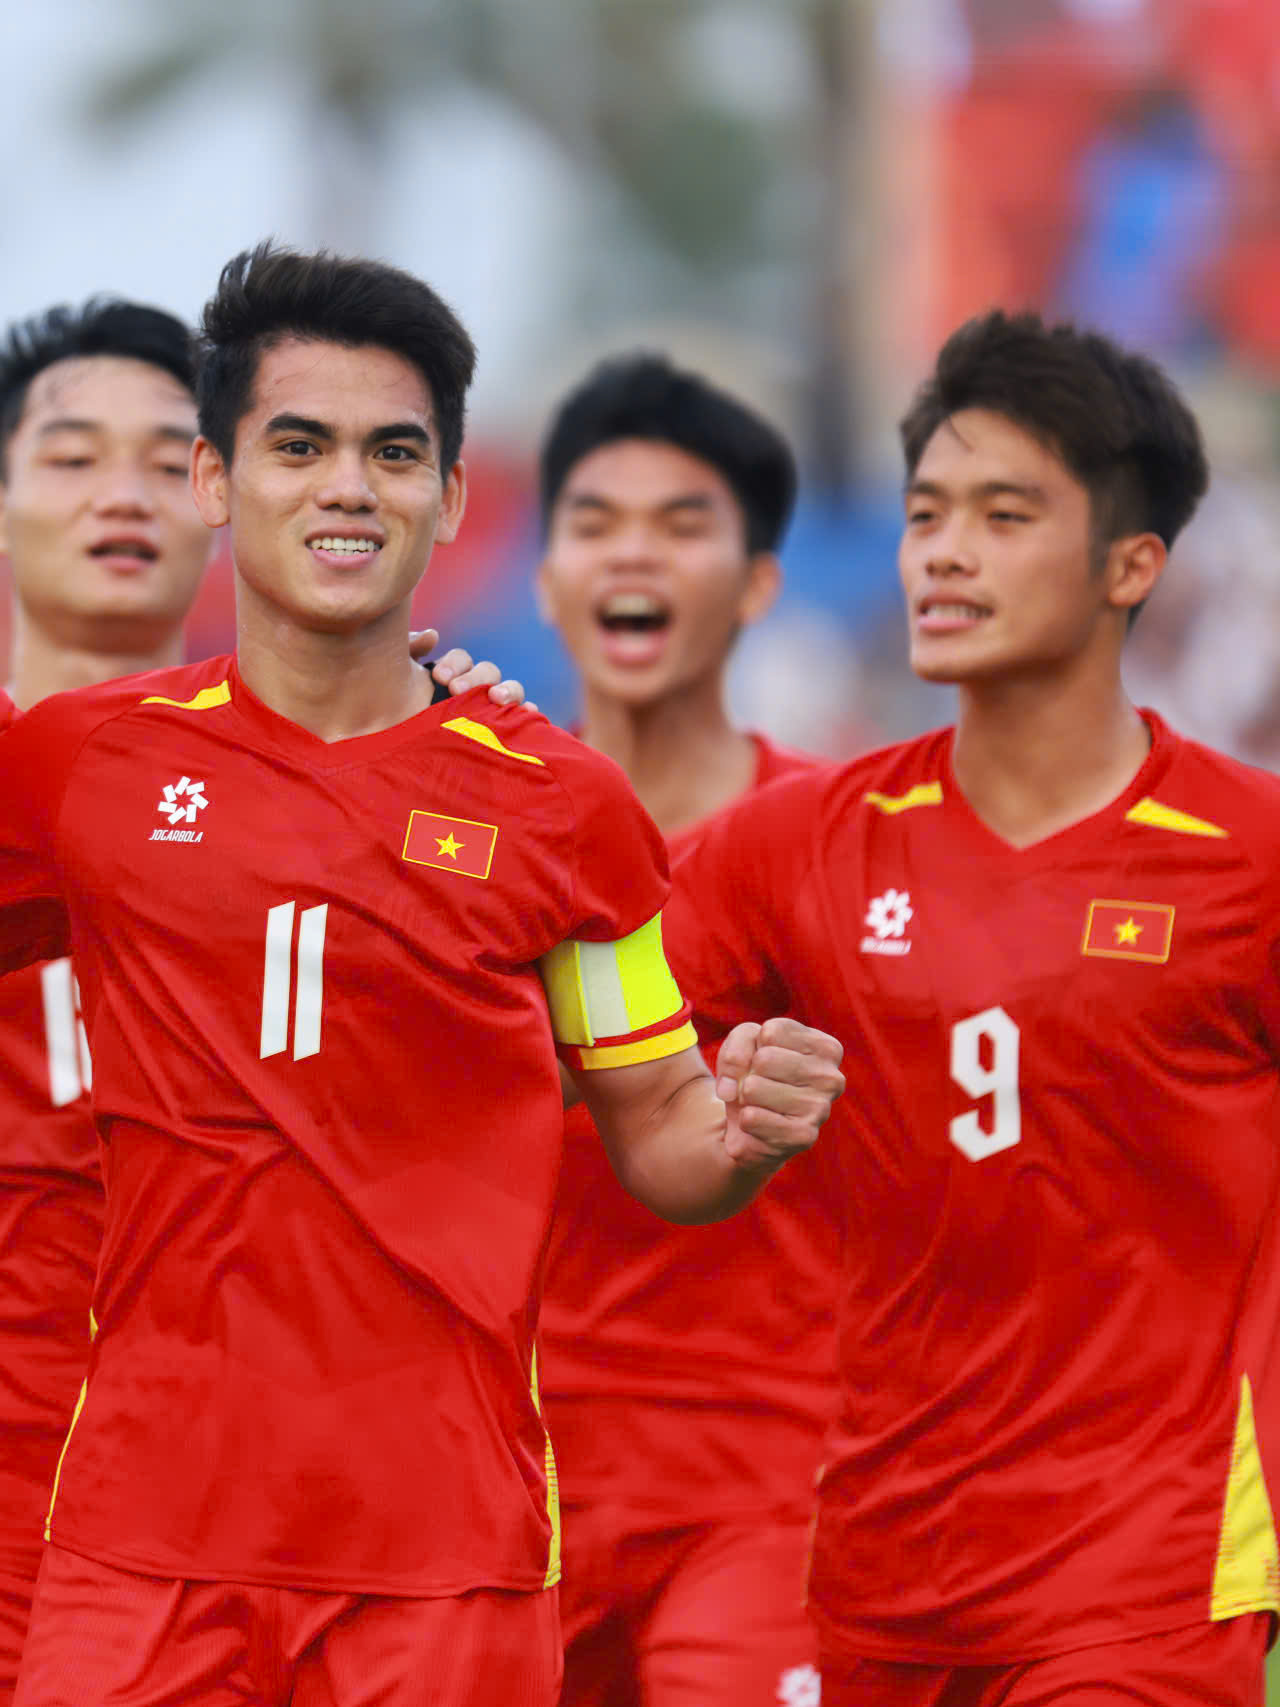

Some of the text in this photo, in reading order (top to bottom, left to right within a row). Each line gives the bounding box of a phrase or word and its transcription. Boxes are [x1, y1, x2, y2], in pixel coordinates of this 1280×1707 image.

[148, 829, 204, 843] JOCARBOLA
[41, 956, 93, 1108] 1
[259, 900, 329, 1062] 11
[949, 1005, 1022, 1164] 9
